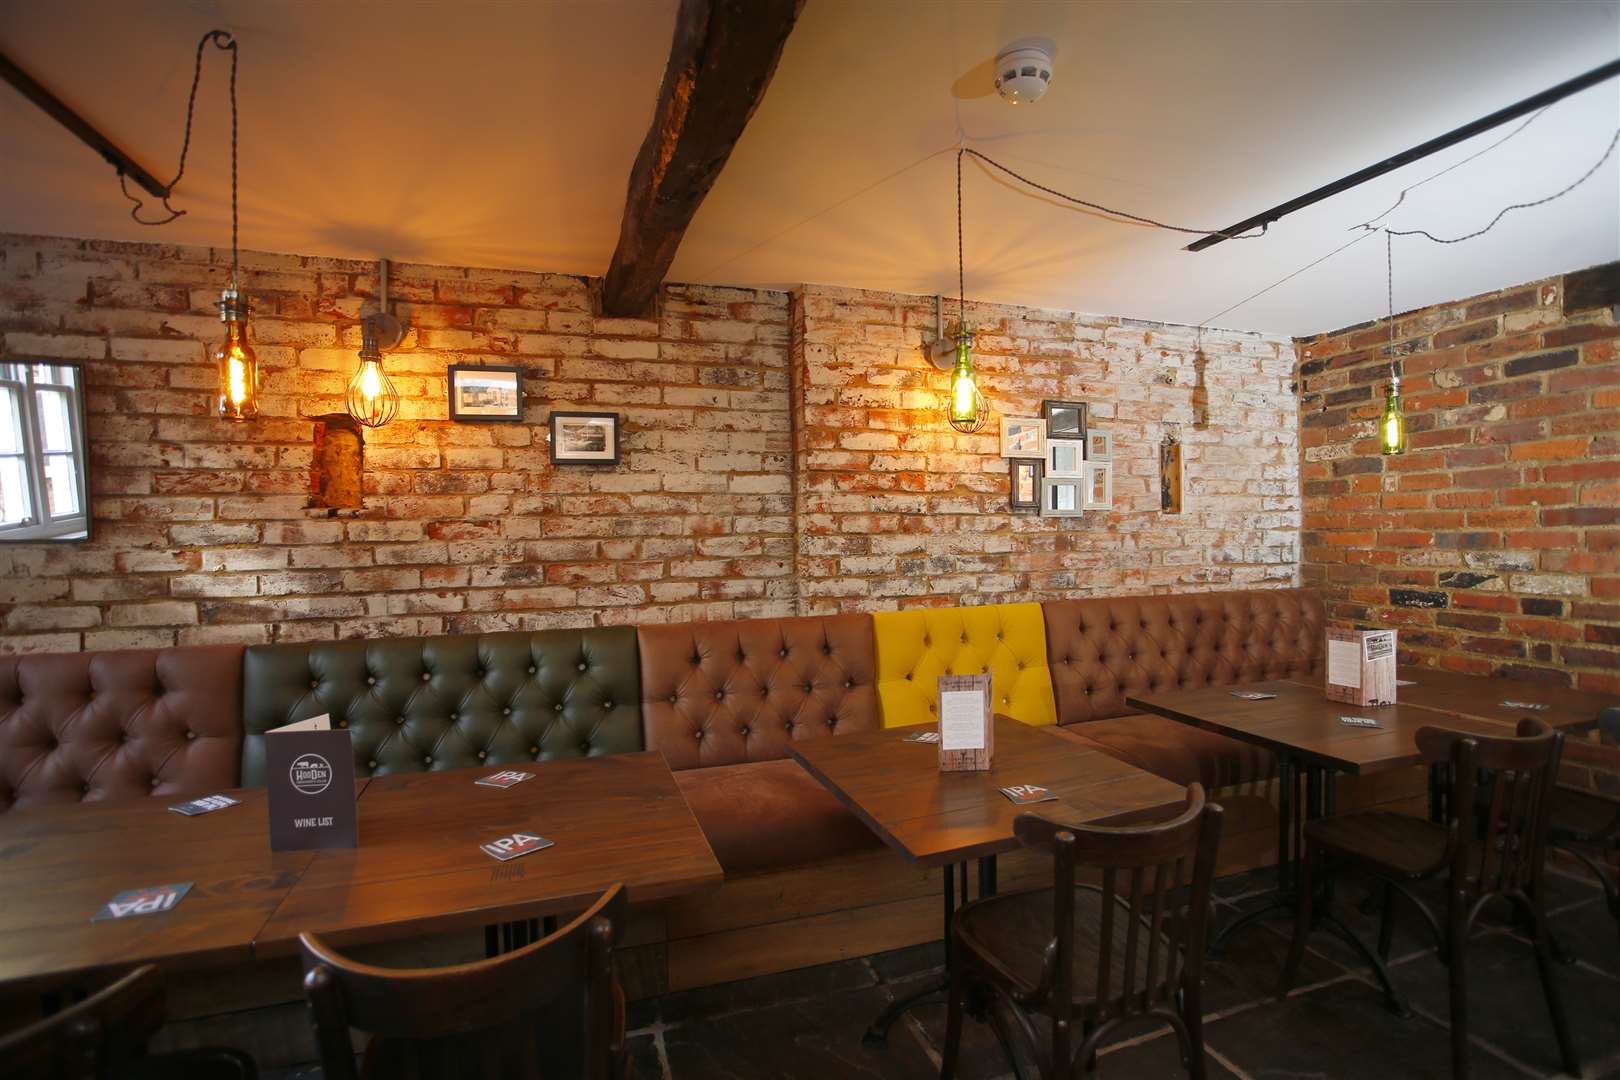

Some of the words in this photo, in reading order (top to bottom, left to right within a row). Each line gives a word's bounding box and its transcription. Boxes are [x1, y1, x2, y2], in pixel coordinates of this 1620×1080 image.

[488, 770, 528, 782] IPA
[1001, 784, 1049, 797] IPA
[294, 817, 317, 828] WINE
[318, 816, 333, 827] LIST
[484, 833, 542, 854] IPA
[108, 892, 178, 918] IPA
